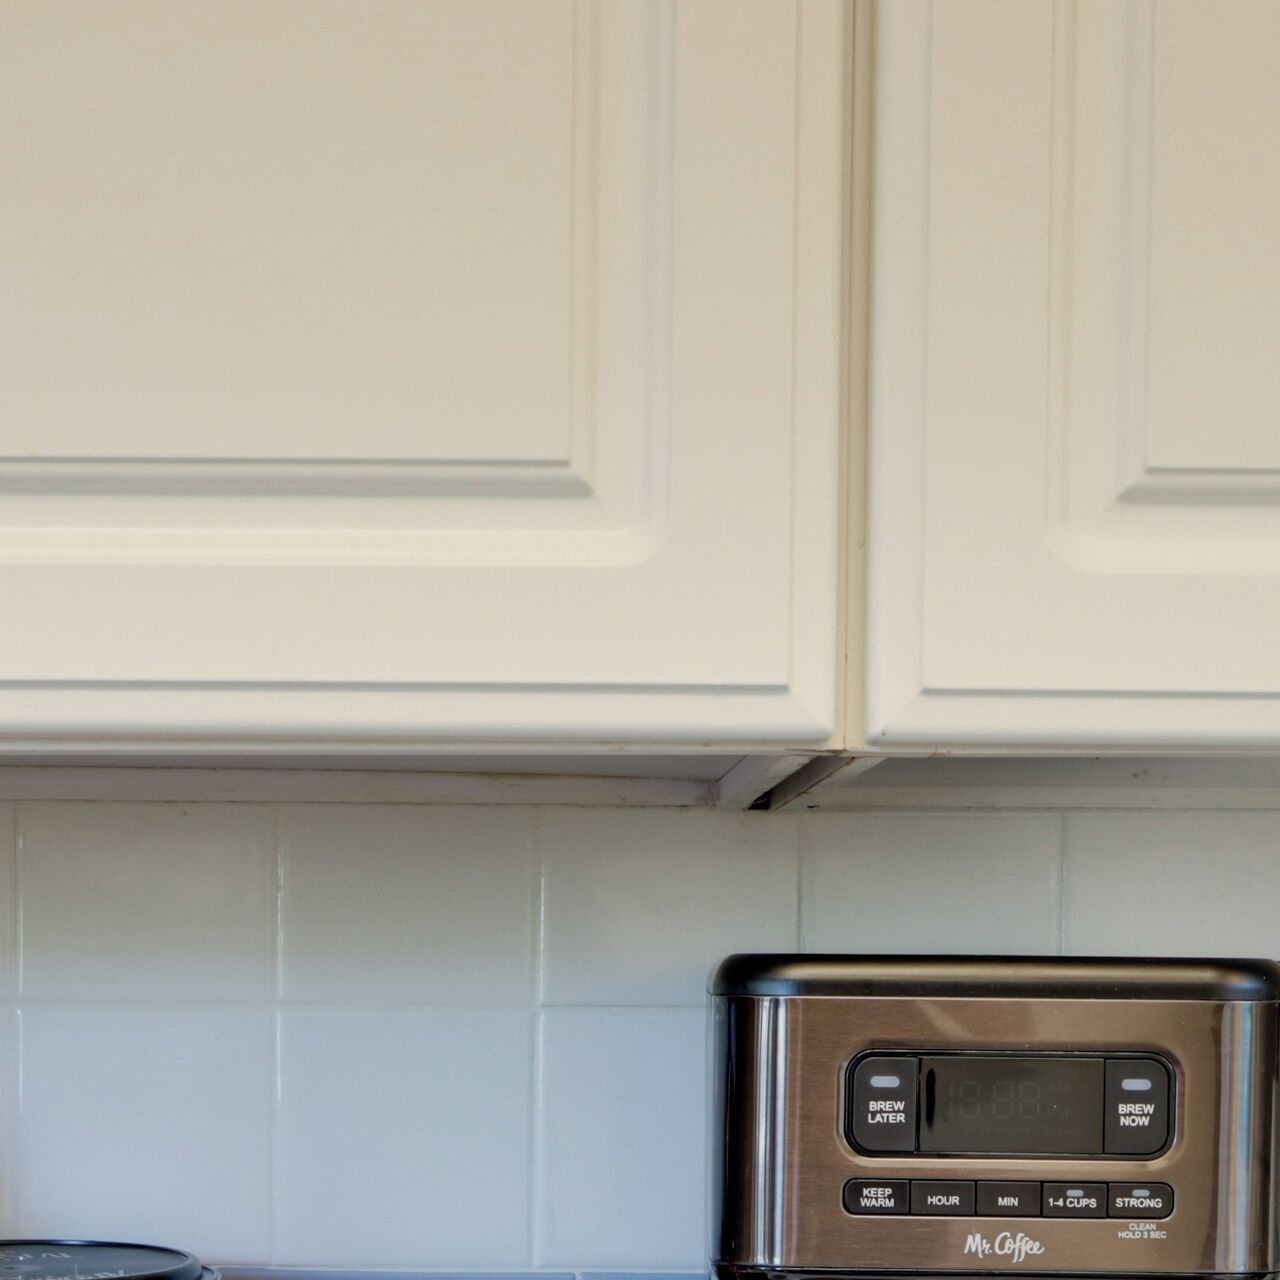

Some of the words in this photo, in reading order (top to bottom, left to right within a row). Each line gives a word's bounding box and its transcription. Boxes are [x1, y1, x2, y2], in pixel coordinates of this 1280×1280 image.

[869, 1101, 905, 1111] BREW
[1118, 1104, 1154, 1115] BREW
[868, 1113, 906, 1123] LATER
[1120, 1116, 1150, 1126] NOW
[862, 1188, 893, 1198] KEEP
[860, 1198, 895, 1208] WARM
[927, 1195, 960, 1206] HOUR
[998, 1197, 1018, 1207] MIN
[1048, 1198, 1064, 1207] 1-4
[1066, 1198, 1097, 1208] CUPS
[1116, 1198, 1163, 1208] STRONG
[1128, 1223, 1157, 1231] CLEAN
[1118, 1231, 1141, 1239] HOLD
[1142, 1231, 1148, 1239] 3
[1149, 1231, 1167, 1239] SEC
[964, 1233, 993, 1259] Mr.
[994, 1232, 1045, 1263] Coffee
